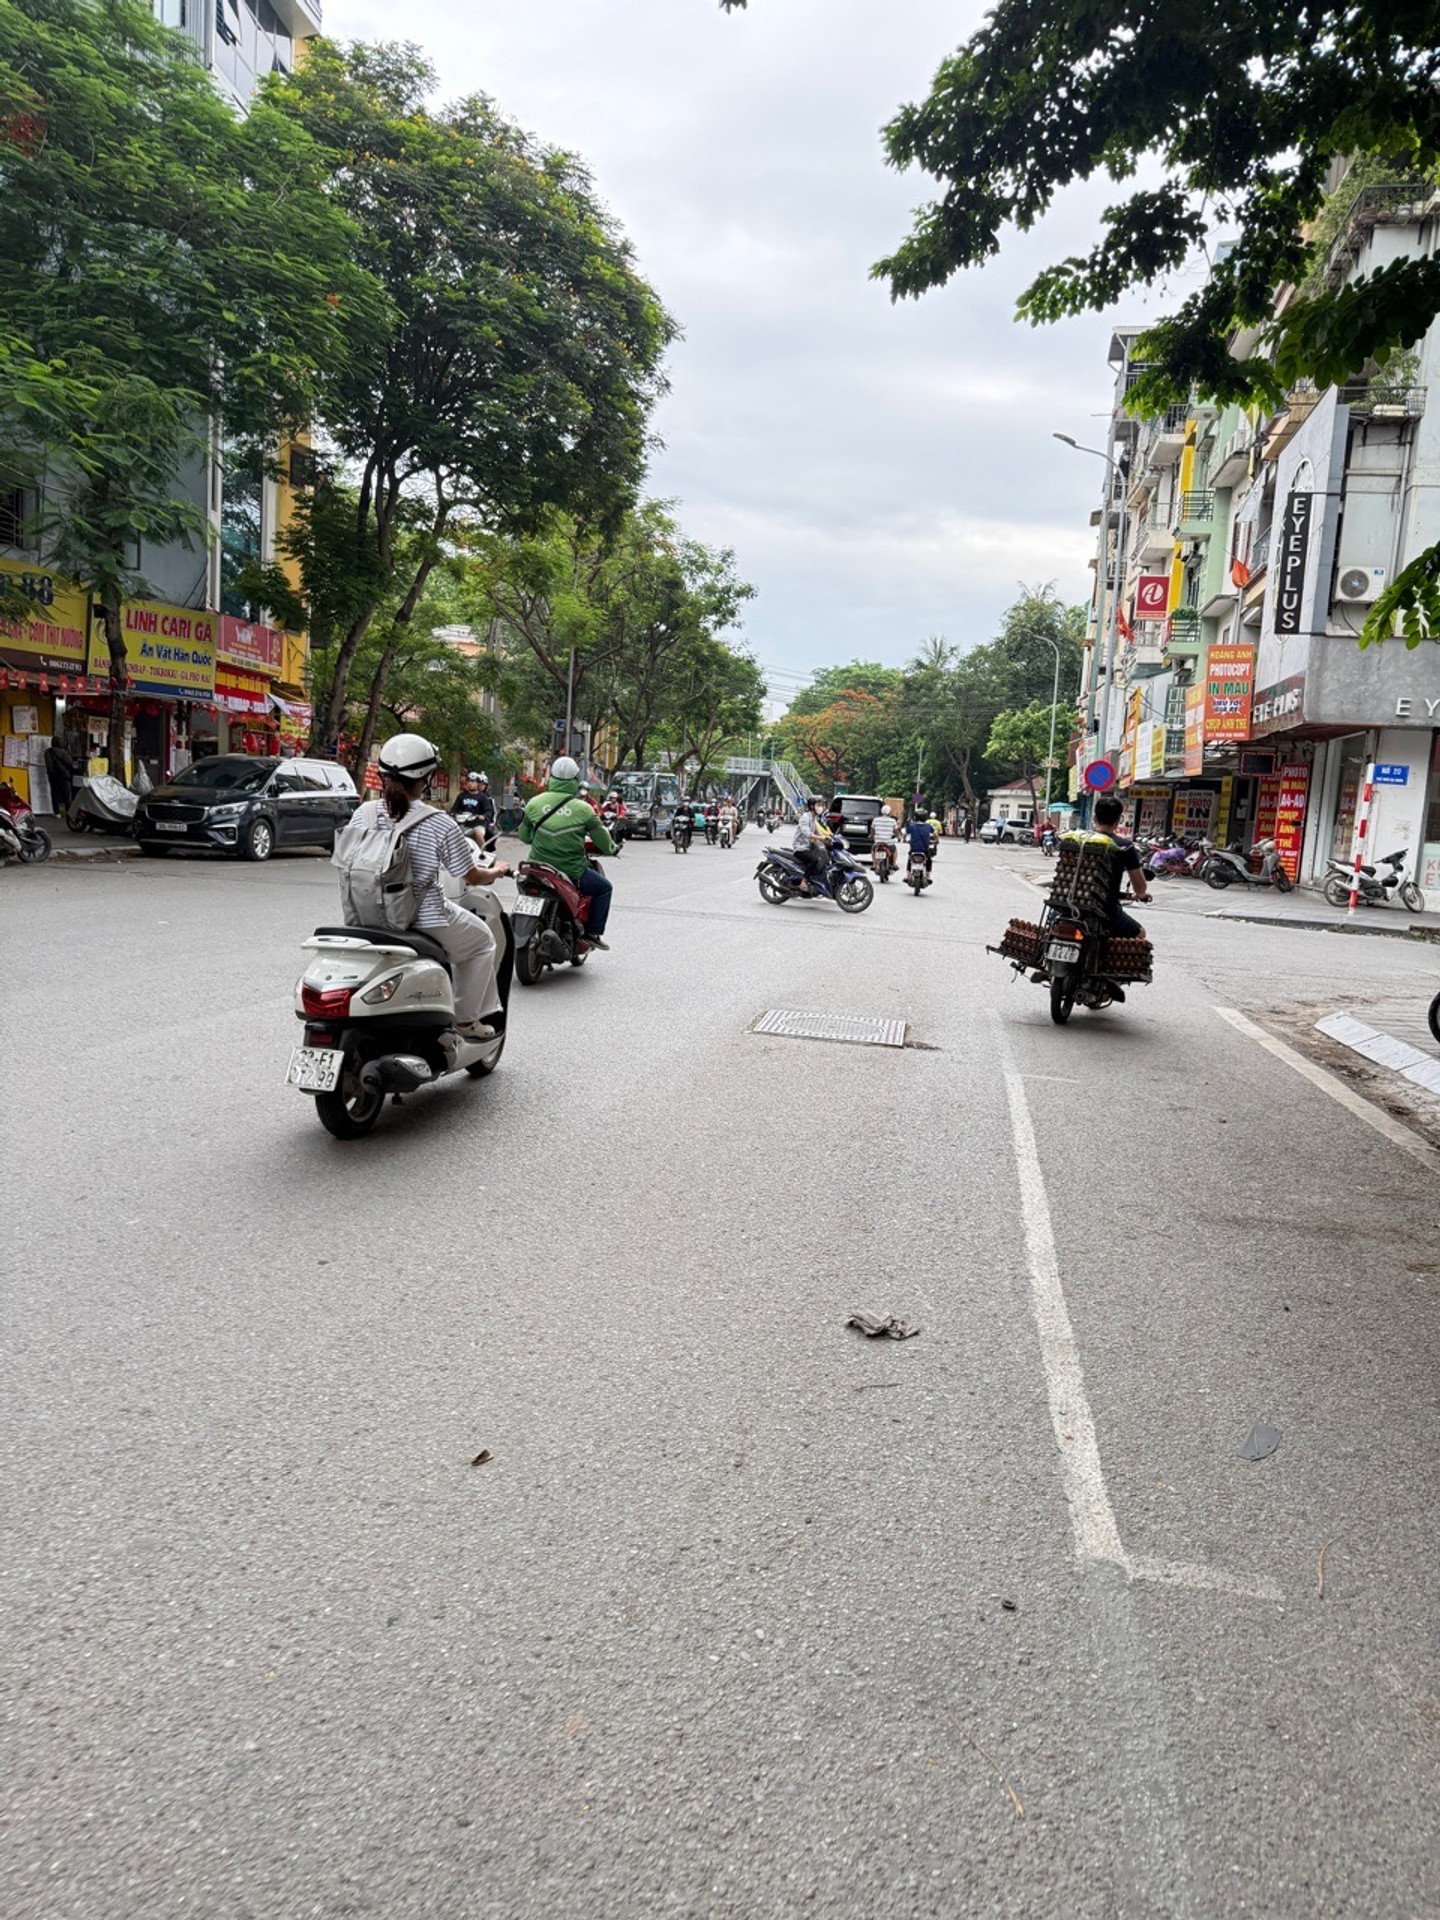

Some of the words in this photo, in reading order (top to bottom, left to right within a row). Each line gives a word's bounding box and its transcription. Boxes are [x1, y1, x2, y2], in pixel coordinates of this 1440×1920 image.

[1281, 498, 1307, 629] EYEPLUS
[126, 608, 158, 633] LINH
[161, 615, 191, 640] CARI
[1209, 663, 1251, 677] PHOTOCOPY
[1208, 681, 1221, 695] IN
[1284, 767, 1308, 778] PHOTO
[542, 804, 573, 817] Gab
